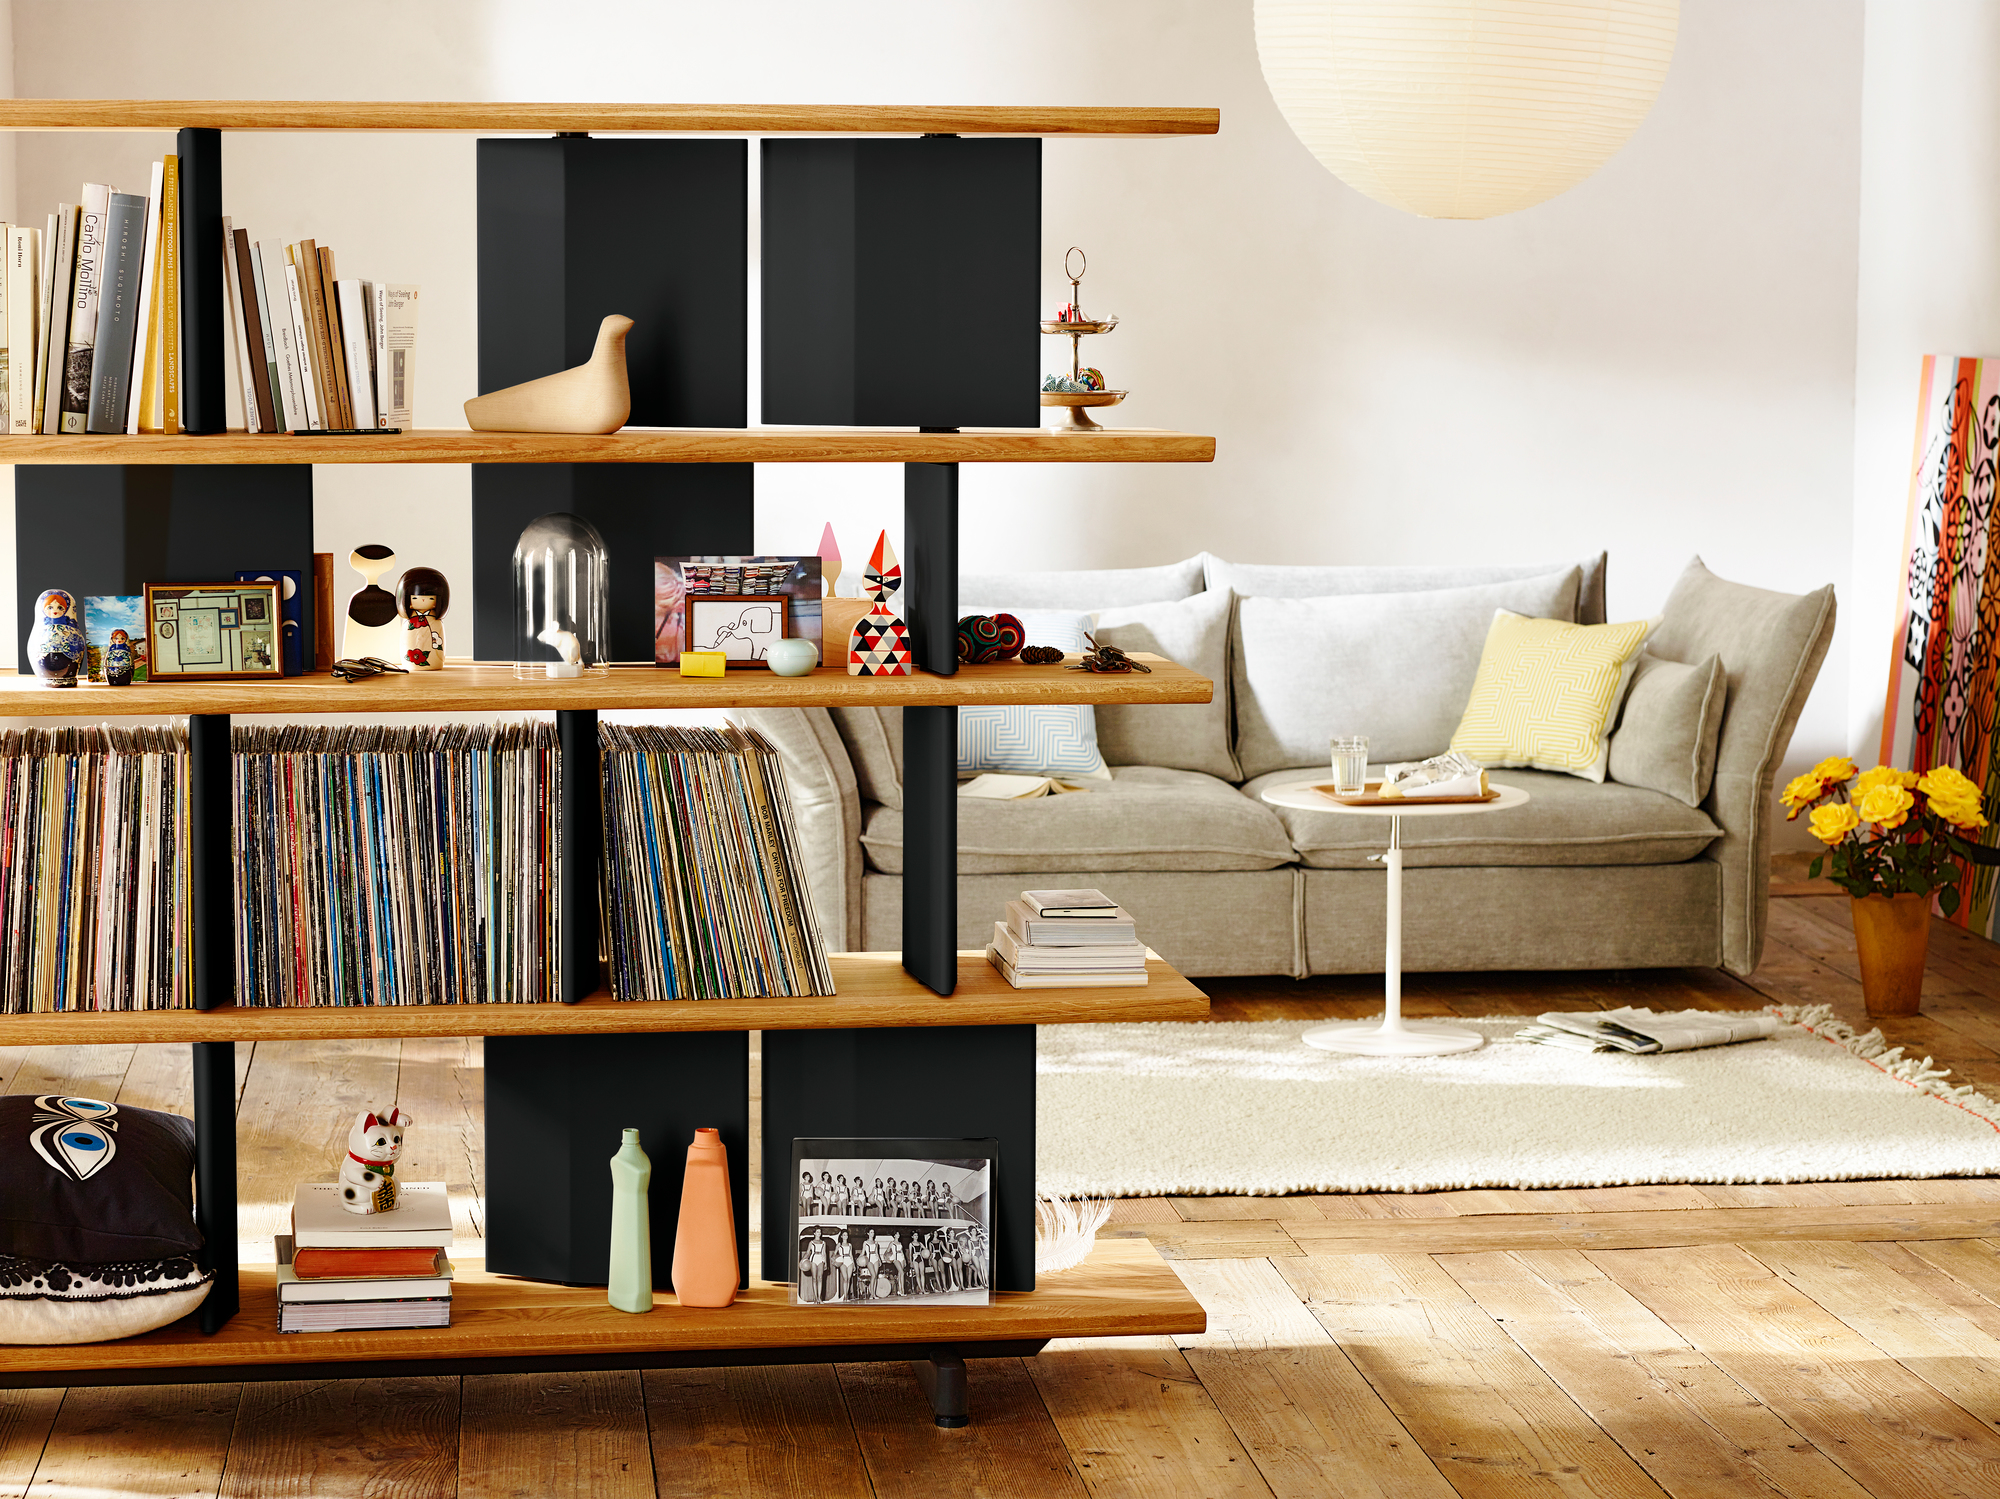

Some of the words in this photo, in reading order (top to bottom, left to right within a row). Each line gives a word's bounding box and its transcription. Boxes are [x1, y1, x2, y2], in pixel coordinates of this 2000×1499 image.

[82, 214, 98, 254] Carlo
[120, 219, 129, 263] HIROSHI
[77, 258, 94, 309] Mollino
[114, 269, 125, 322] SUGIMOTO
[760, 805, 769, 820] BOB
[764, 821, 776, 848] MARLEY
[771, 852, 782, 877] CRYING
[777, 879, 787, 894] FOR
[781, 894, 794, 927] FREEDOM
